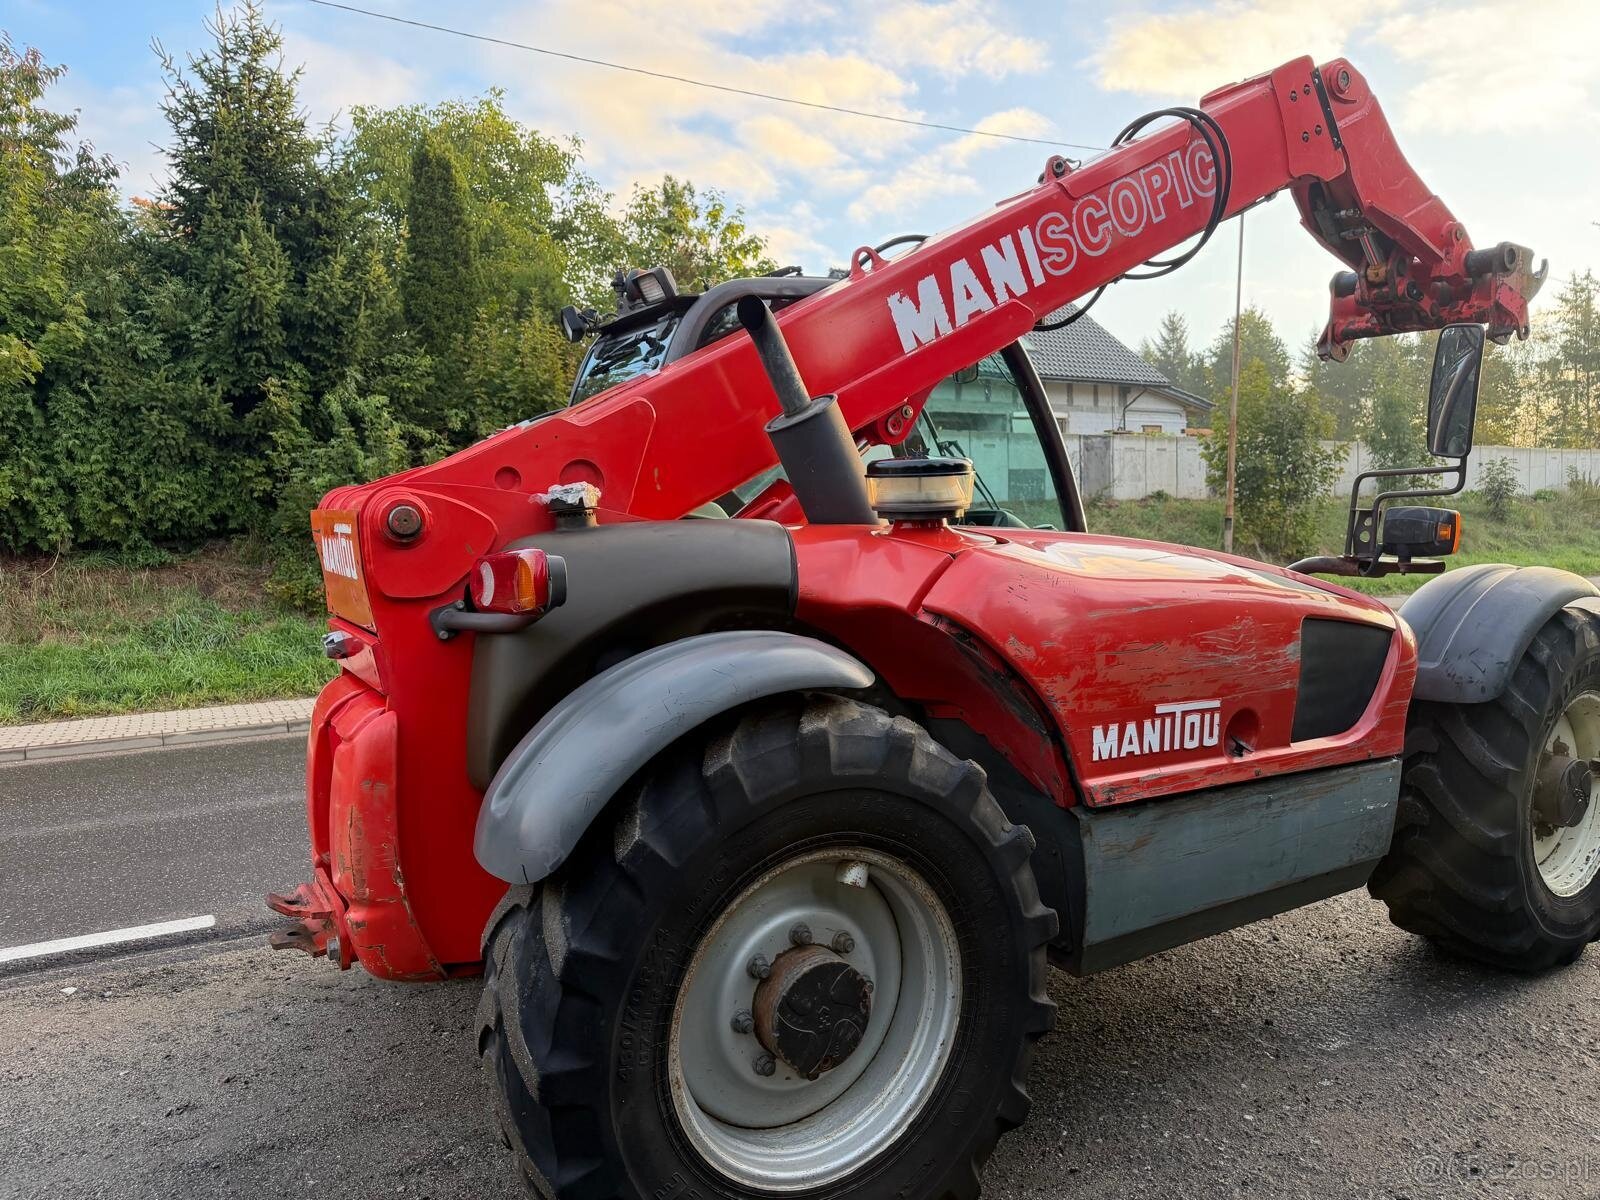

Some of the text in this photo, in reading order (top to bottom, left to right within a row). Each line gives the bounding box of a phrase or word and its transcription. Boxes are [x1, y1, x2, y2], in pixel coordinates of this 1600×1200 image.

[887, 139, 1217, 356] MANISCOPIC
[322, 523, 358, 580] MANITOU
[1092, 699, 1222, 761] MANITOU
